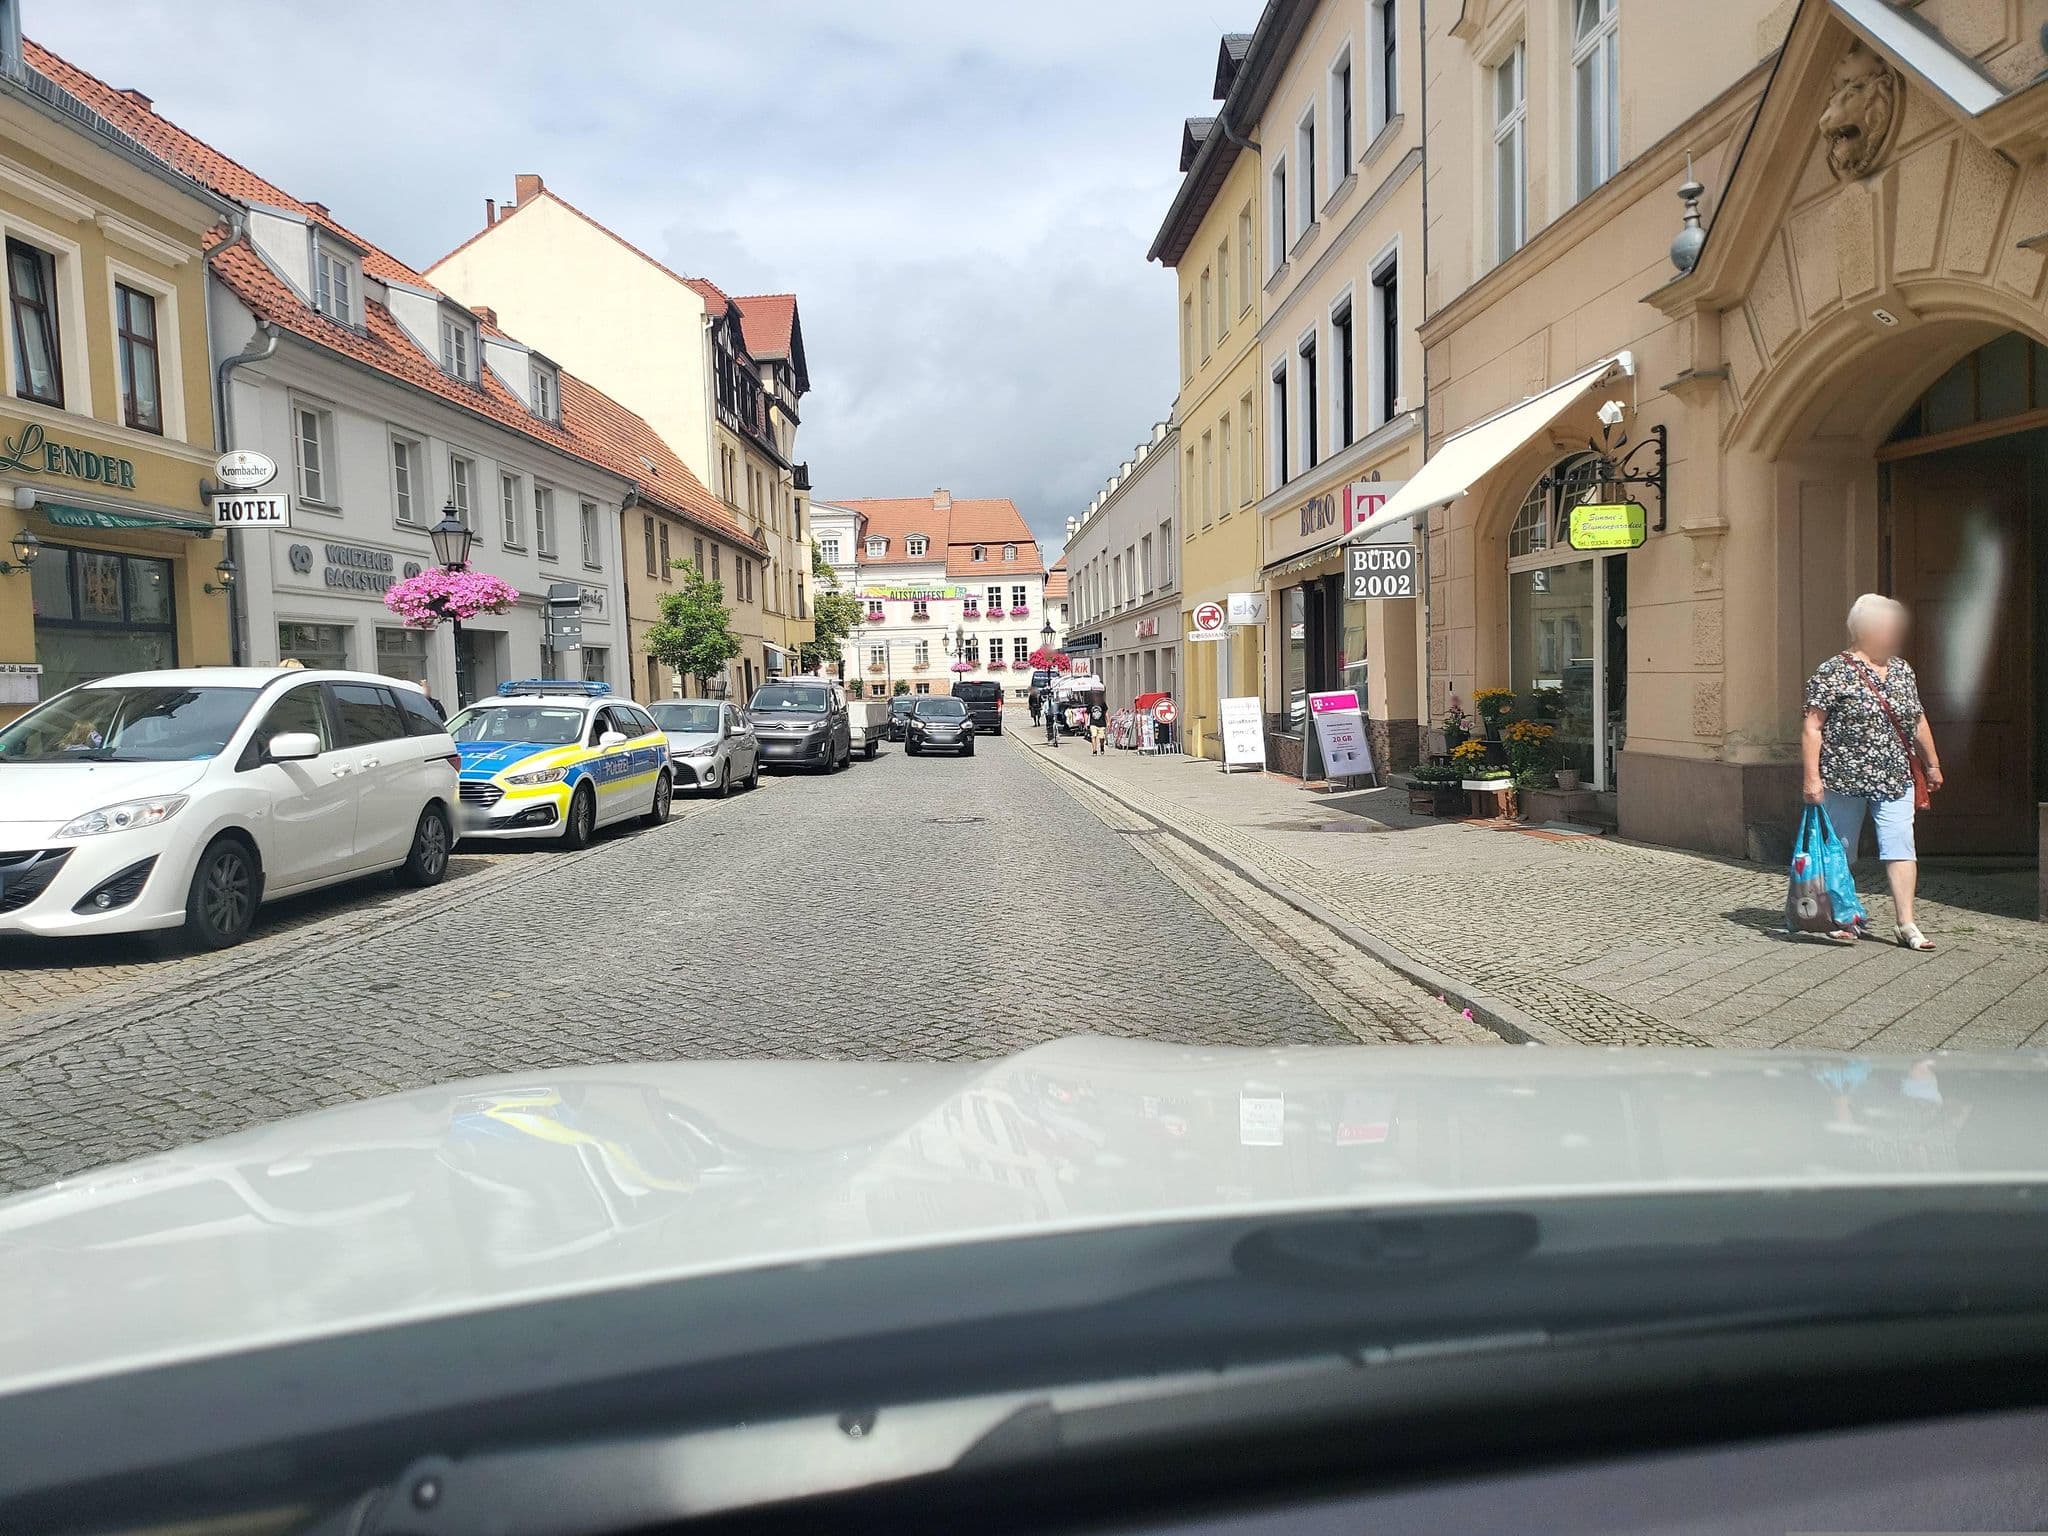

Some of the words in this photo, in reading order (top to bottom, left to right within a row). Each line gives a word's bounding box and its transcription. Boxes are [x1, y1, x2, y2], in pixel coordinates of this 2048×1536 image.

[221, 464, 268, 477] Krombacher
[218, 500, 280, 521] HOTEL
[1300, 493, 1336, 536] BÜRO
[1356, 495, 1386, 522] T
[325, 543, 394, 571] WRIEZENER
[1353, 549, 1411, 571] BÜRO
[890, 590, 946, 601] ALTSTADTFEST
[1354, 575, 1410, 596] 2002
[1233, 601, 1262, 618] sky
[1332, 736, 1342, 744] 20
